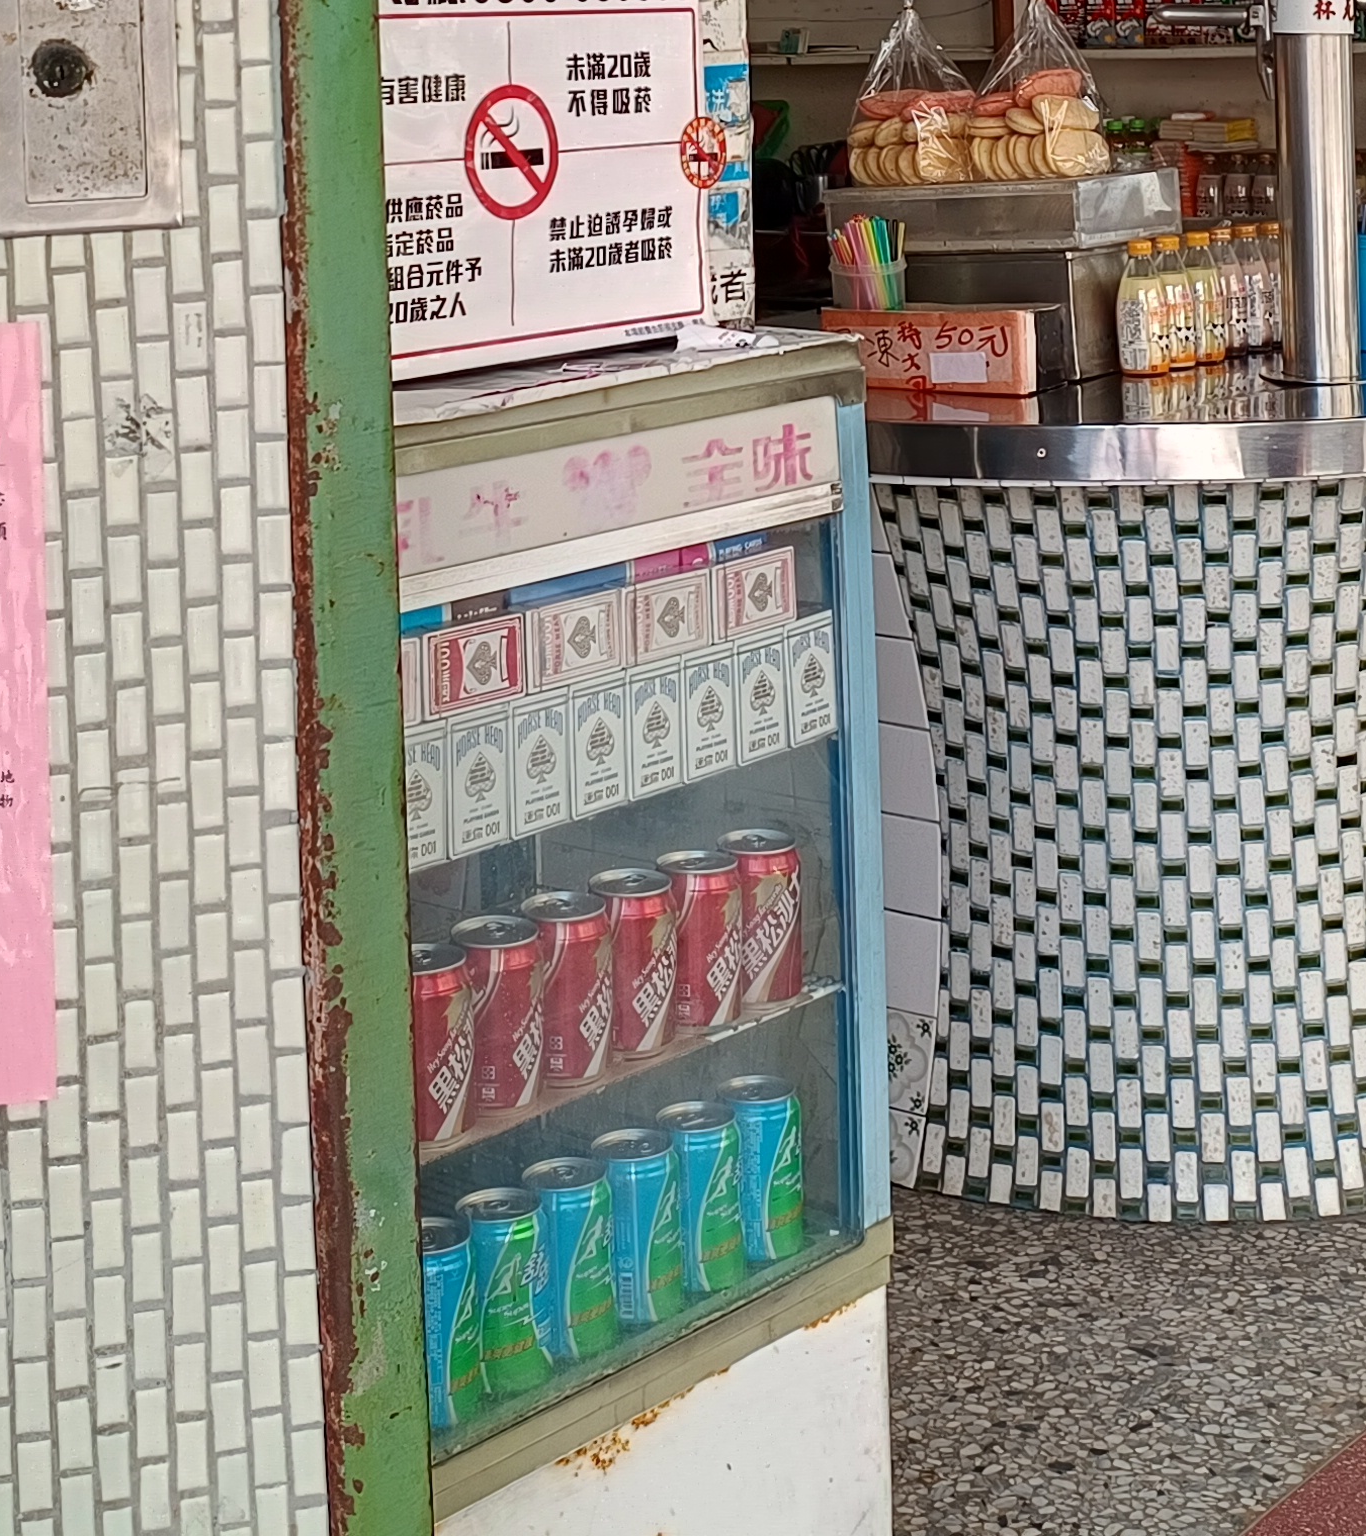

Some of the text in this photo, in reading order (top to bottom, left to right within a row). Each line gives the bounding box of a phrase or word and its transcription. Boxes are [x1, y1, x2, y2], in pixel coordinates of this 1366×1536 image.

[566, 50, 651, 82] 未滿20歲
[381, 73, 466, 106] 有害健康
[568, 87, 652, 117] 不得吸菸
[385, 193, 464, 224] 供應菸品
[550, 205, 673, 242] 禁止迫誘孕婦或
[550, 236, 673, 274] 未滿20歲者吸菸
[388, 257, 482, 292] 組合元件予
[934, 321, 1009, 358] 50元
